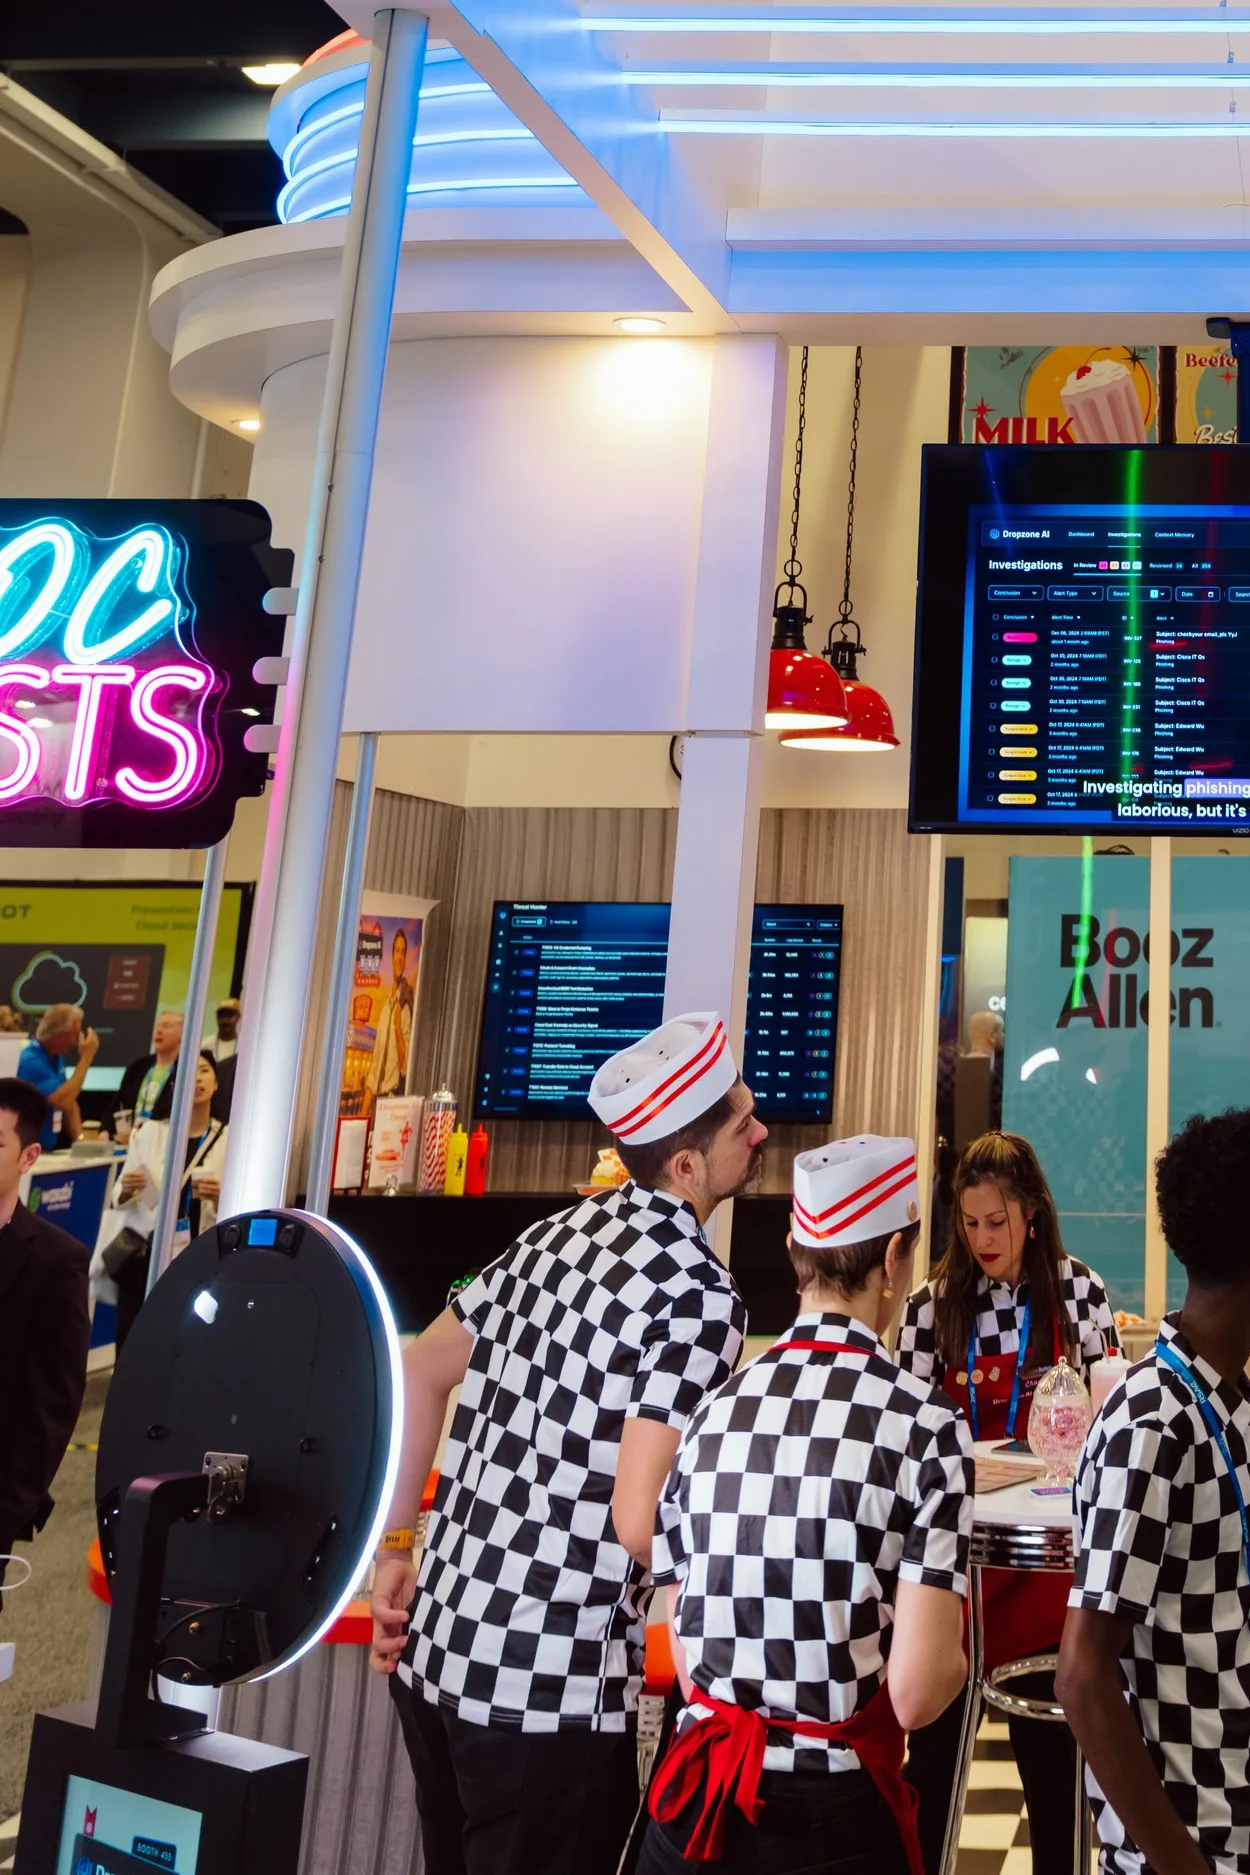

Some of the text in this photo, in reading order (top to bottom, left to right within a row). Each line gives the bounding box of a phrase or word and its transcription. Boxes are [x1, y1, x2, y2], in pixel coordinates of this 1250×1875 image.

[1185, 353, 1238, 368] Beefe
[973, 417, 1077, 444] MILK
[1003, 530, 1050, 539] Dropzone AI
[989, 560, 1063, 572] Investigations
[1083, 780, 1183, 798] Investigating
[1118, 803, 1192, 819] laborious,
[1196, 804, 1222, 818] but
[1226, 804, 1247, 818] it's
[137, 1843, 158, 1857] BOOTH
